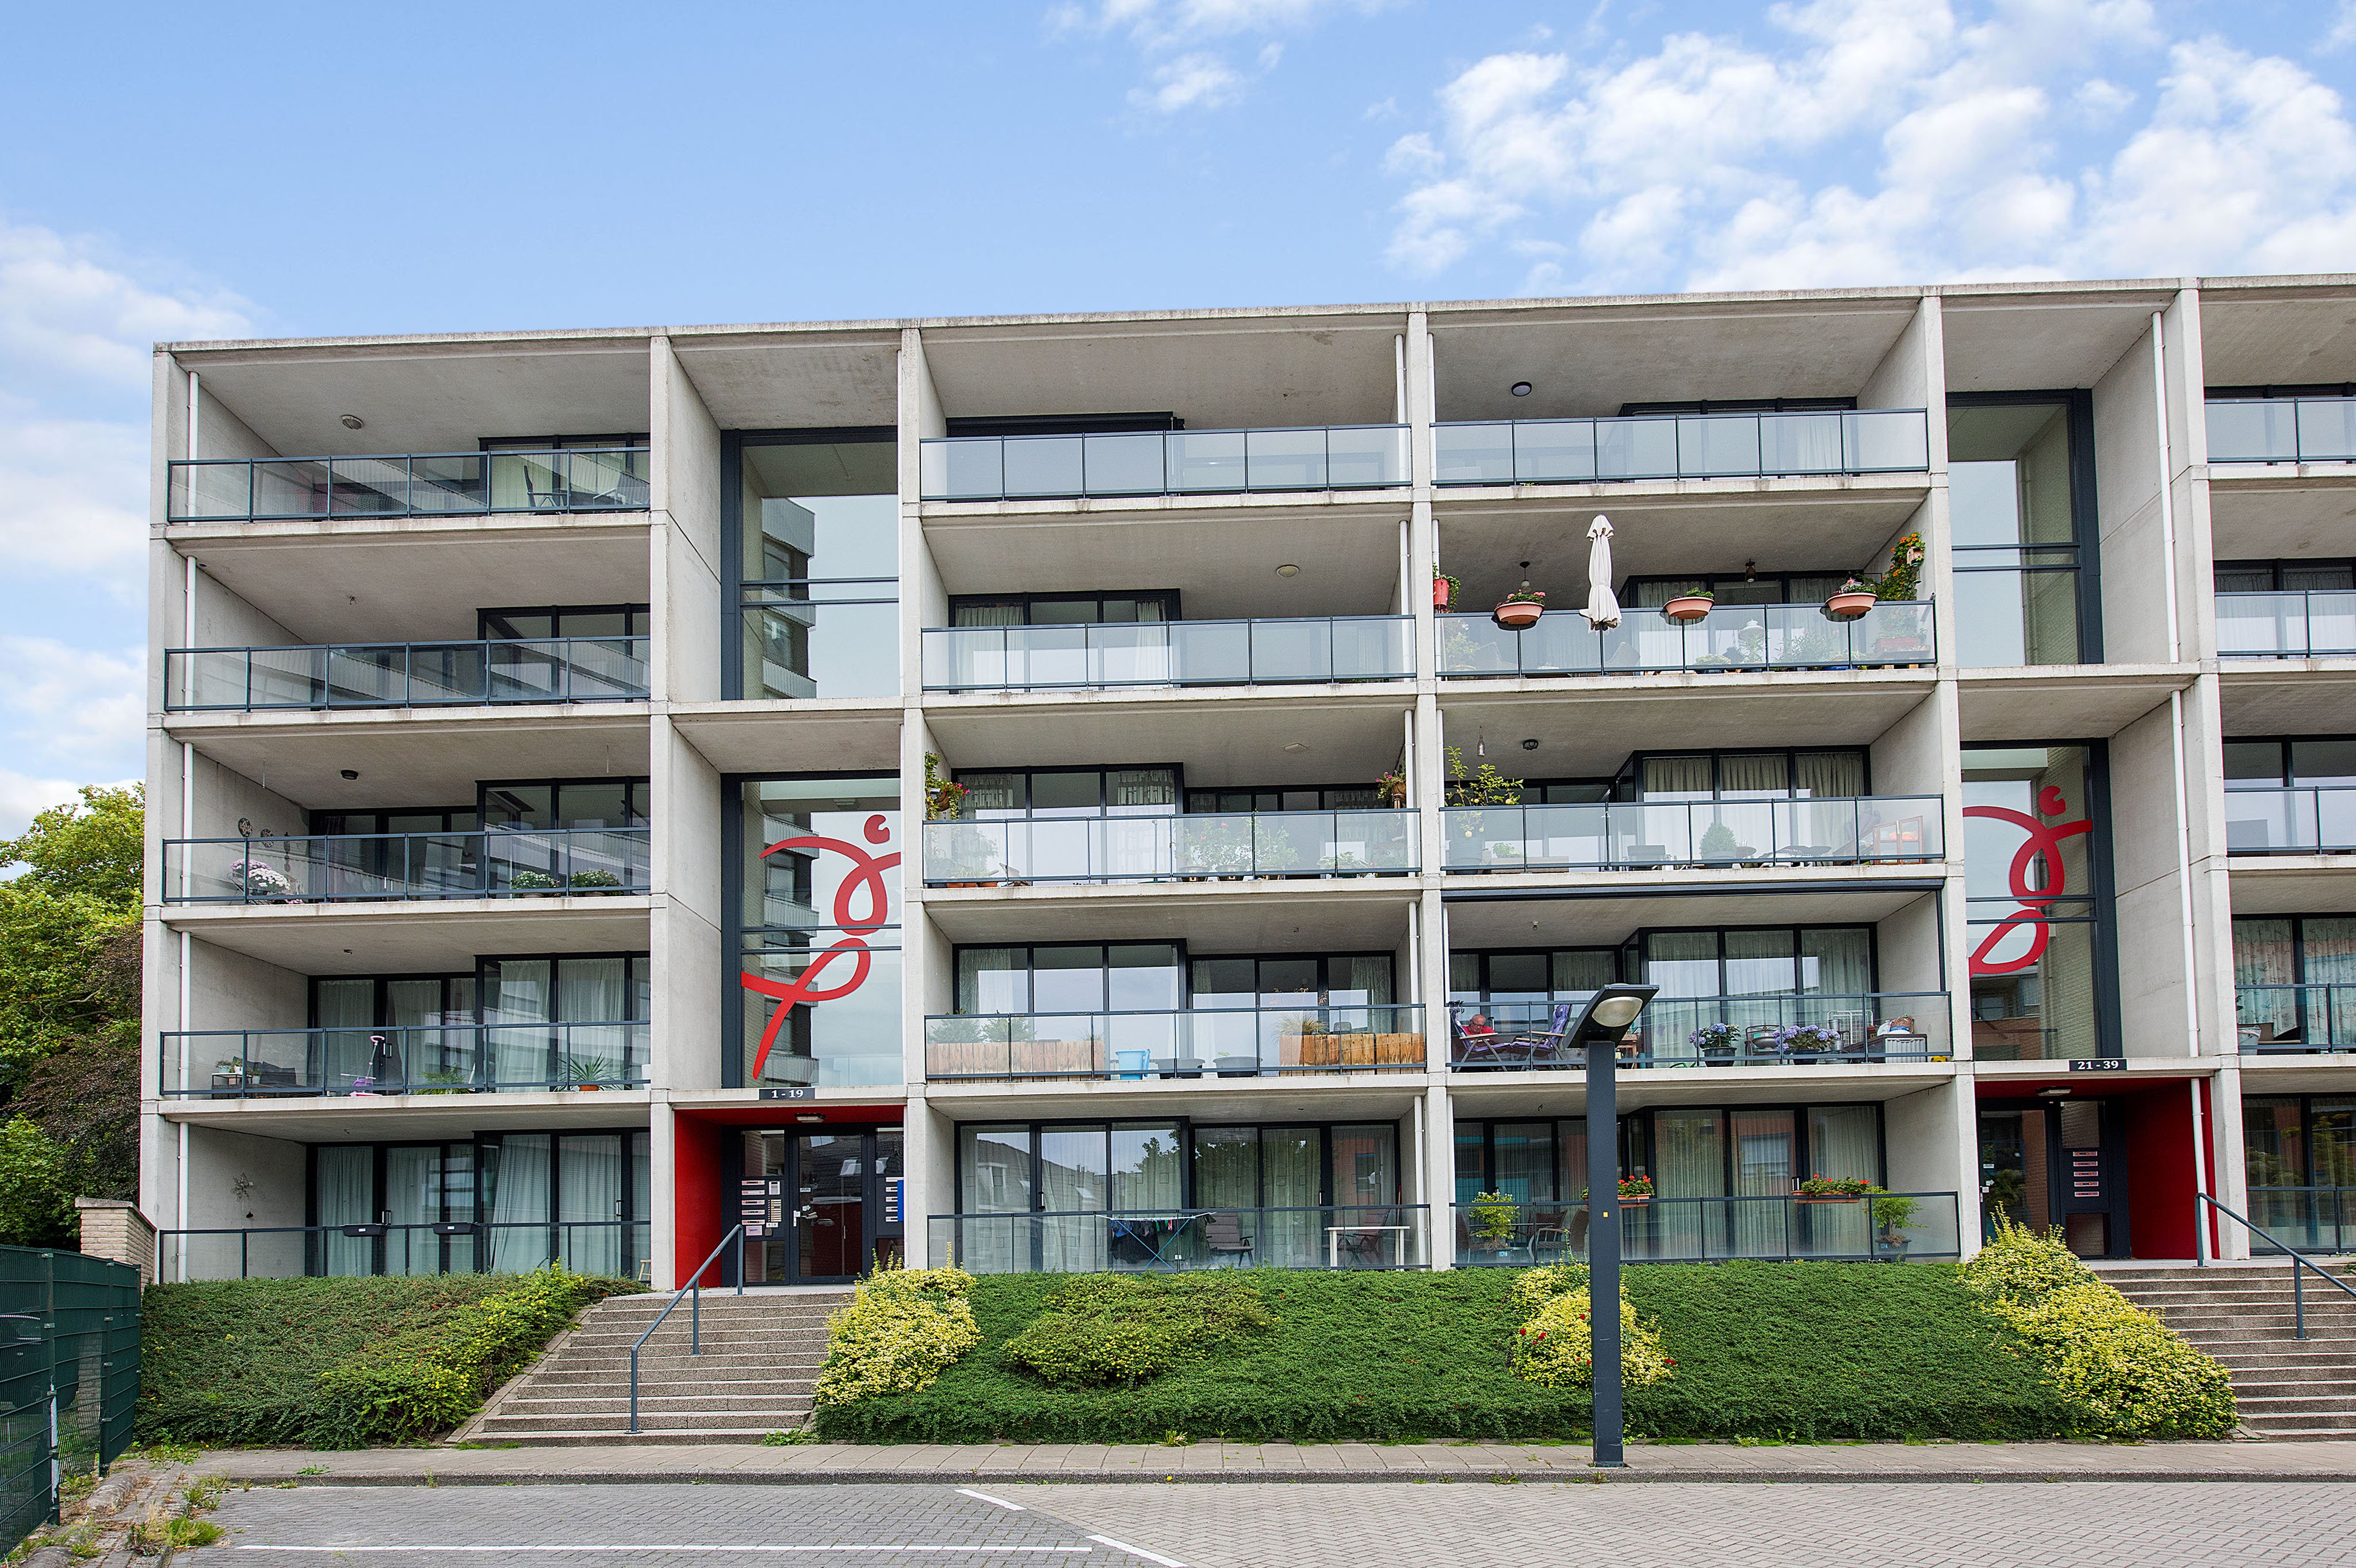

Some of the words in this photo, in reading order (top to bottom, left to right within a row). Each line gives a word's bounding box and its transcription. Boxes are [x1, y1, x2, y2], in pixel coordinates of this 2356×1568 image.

[2078, 1061, 2093, 1069] 21
[2103, 1060, 2119, 1069] 39
[771, 1089, 778, 1098] 1
[789, 1089, 804, 1098] 19
